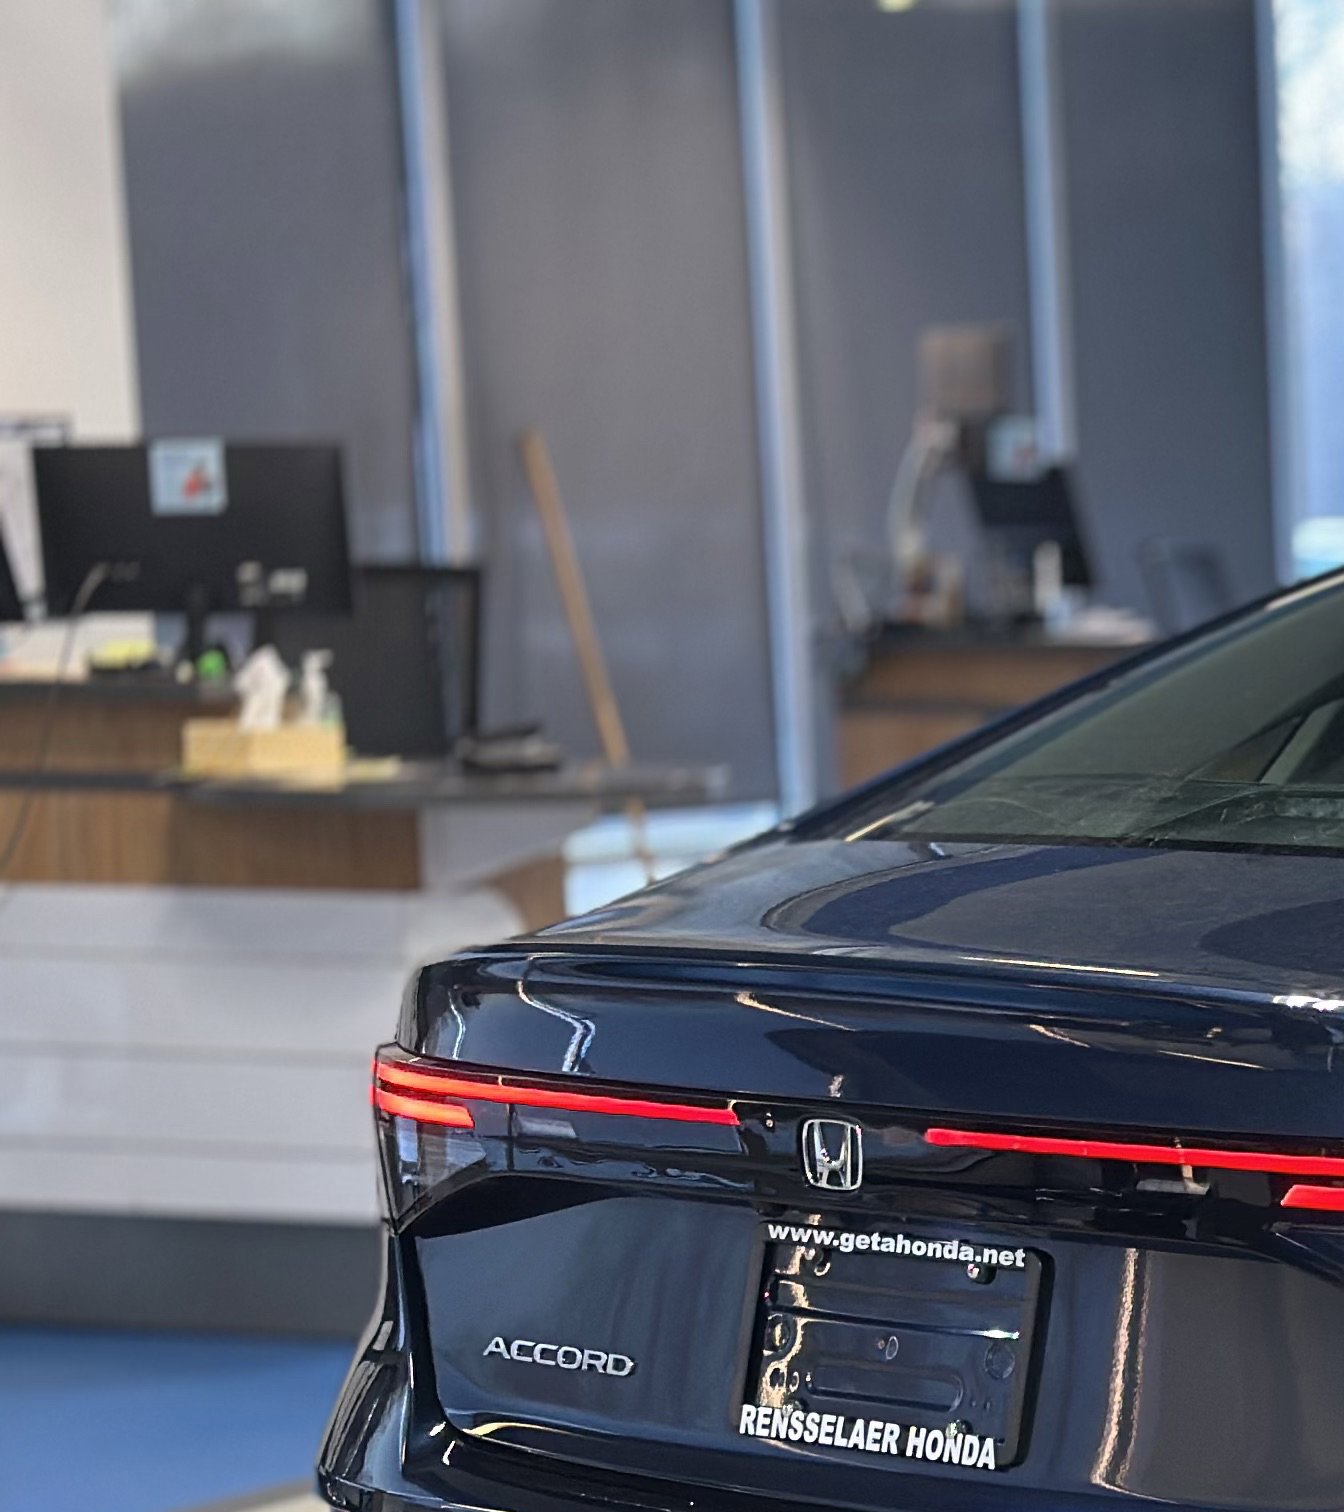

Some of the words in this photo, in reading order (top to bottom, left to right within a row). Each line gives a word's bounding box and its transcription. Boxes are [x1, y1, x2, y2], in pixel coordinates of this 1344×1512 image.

[767, 1223, 1026, 1268] www.getahonda.net
[482, 1336, 635, 1376] ACCORD
[739, 1404, 900, 1454] RENSSELAER
[905, 1425, 996, 1470] HONDA
